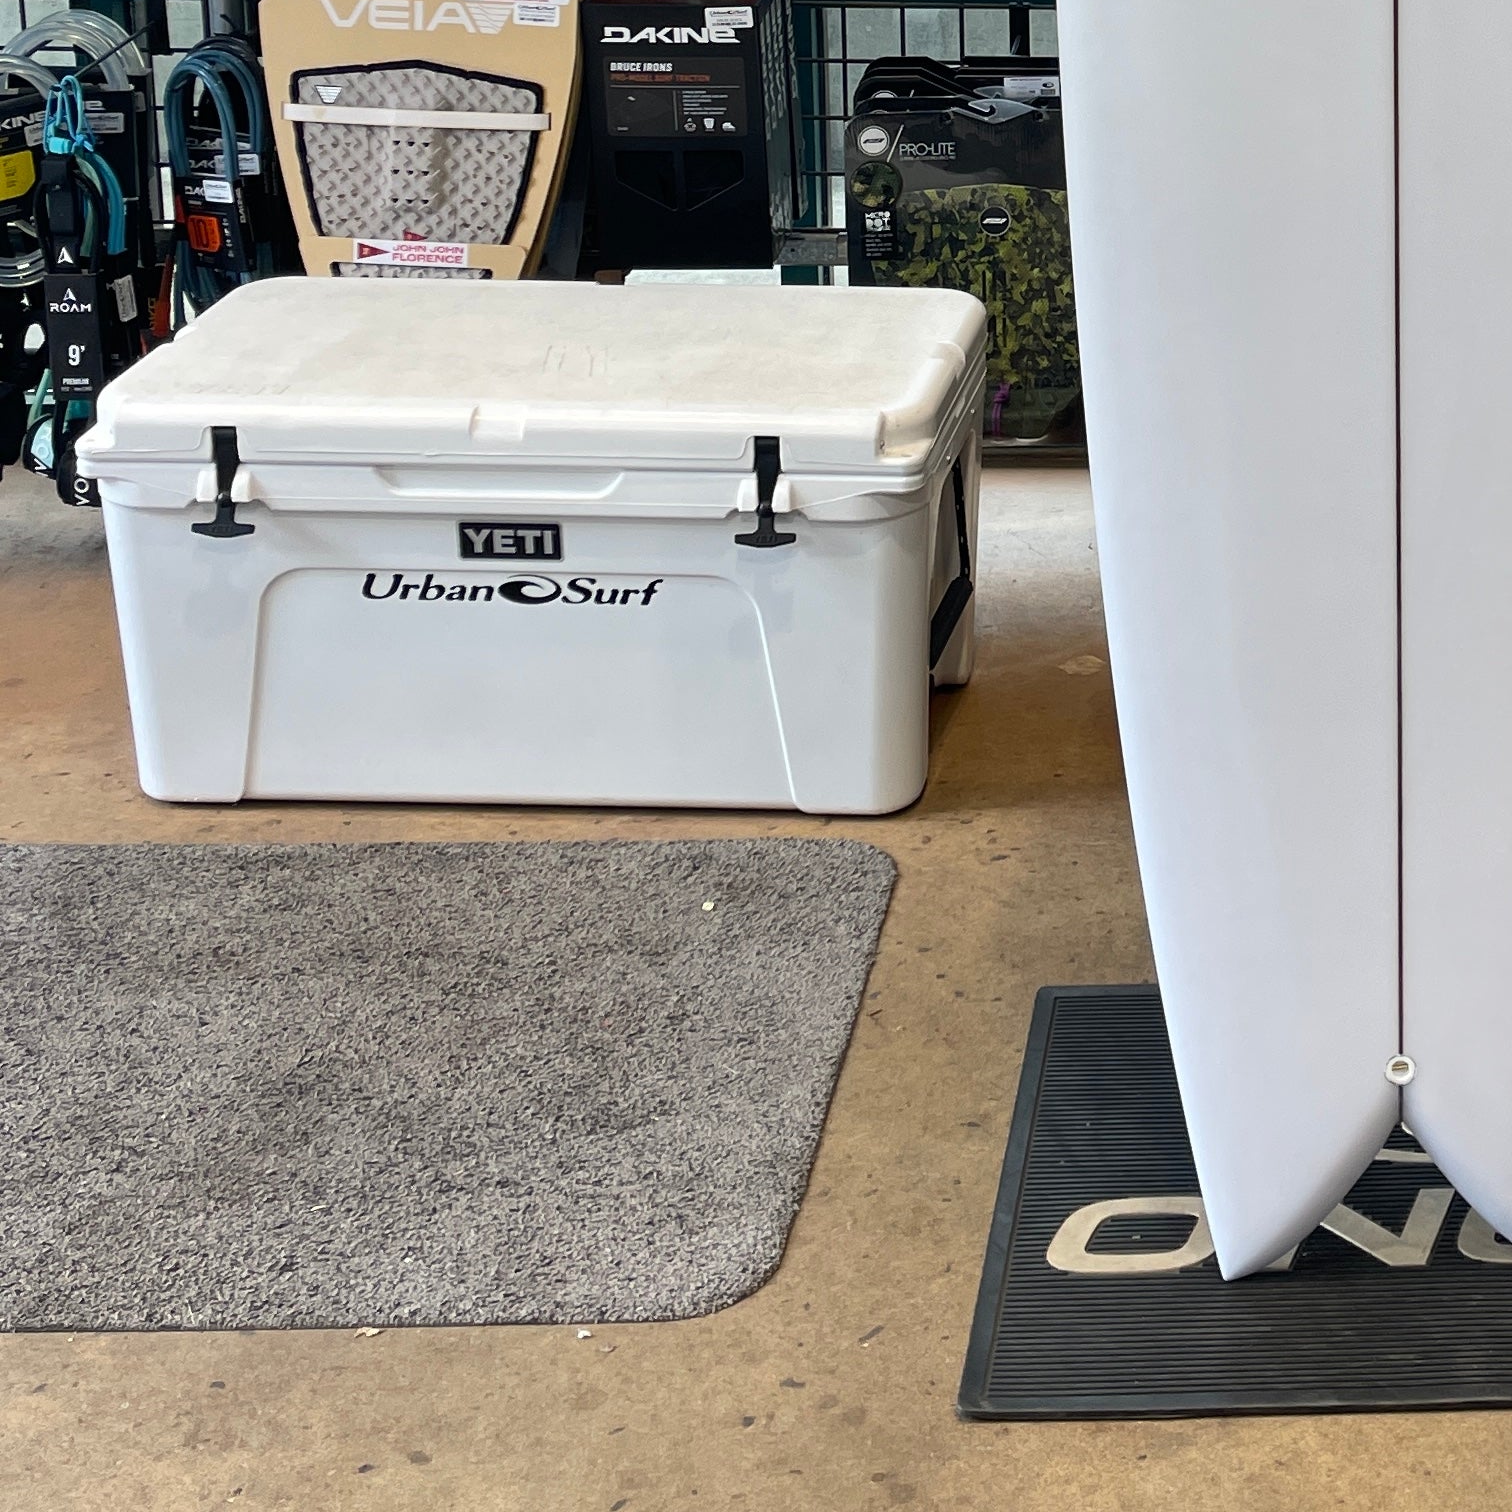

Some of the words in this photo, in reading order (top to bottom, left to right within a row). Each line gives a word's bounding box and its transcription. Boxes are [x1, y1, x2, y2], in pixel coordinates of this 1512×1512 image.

[600, 26, 741, 44] DAKINE
[609, 63, 641, 72] BRUCE
[642, 63, 673, 72] IRONS
[898, 141, 956, 157] PRO-LITE
[392, 244, 427, 253] JOHN
[429, 246, 464, 254] JOHN
[391, 253, 464, 264] FLORENCE
[49, 302, 92, 313] ROAM
[463, 529, 557, 555] YETI
[362, 573, 495, 602] Urban
[561, 577, 664, 606] Surf
